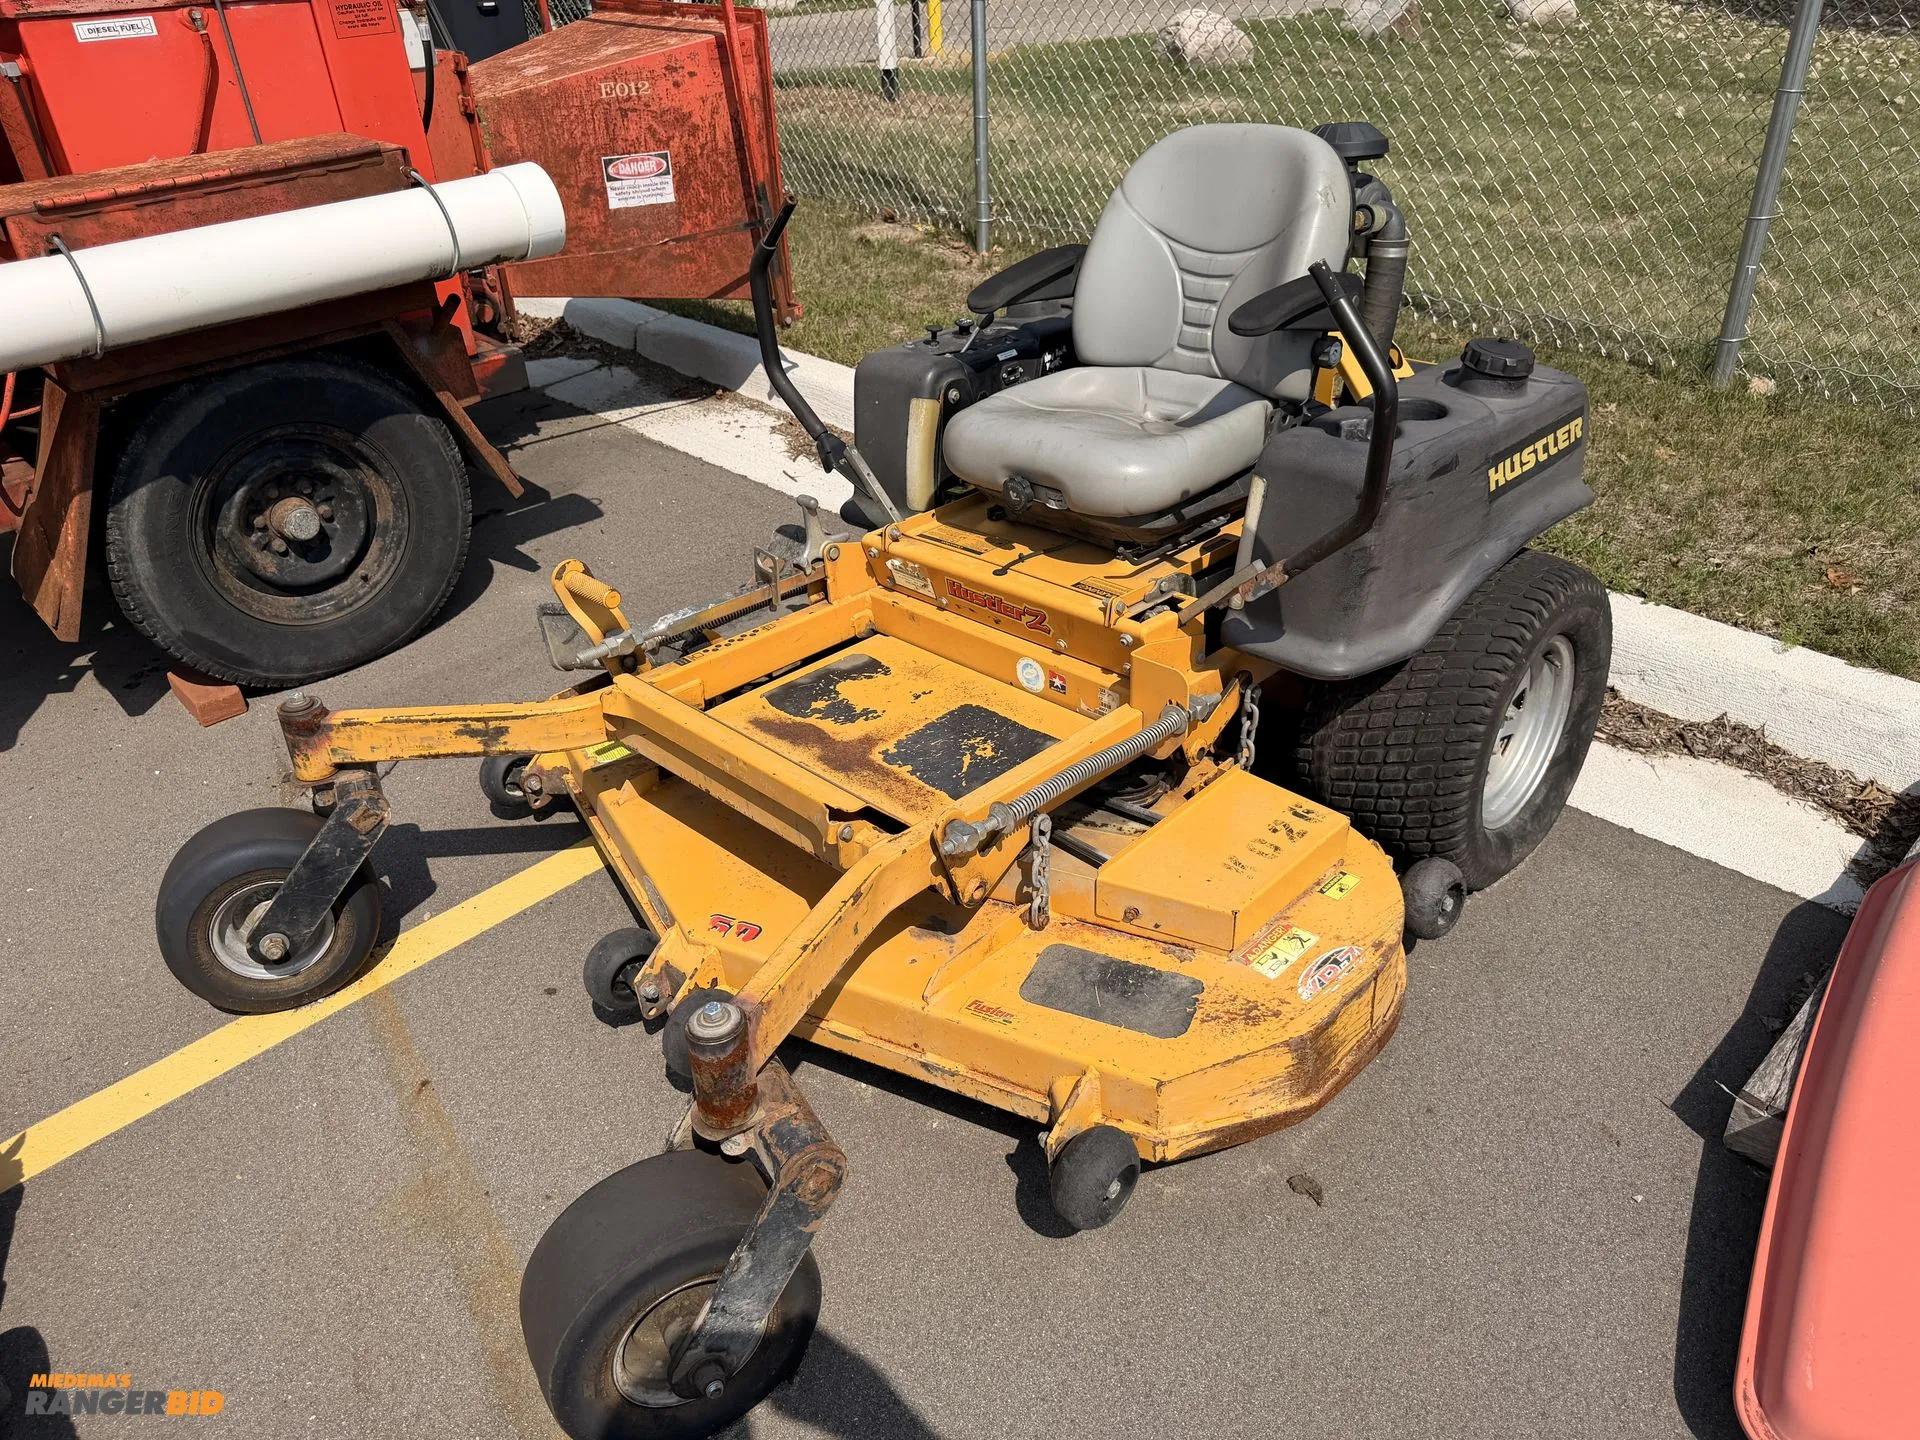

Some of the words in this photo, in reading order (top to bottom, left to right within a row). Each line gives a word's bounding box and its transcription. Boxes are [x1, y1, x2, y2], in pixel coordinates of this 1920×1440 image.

[336, 2, 371, 11] HYDRAULIC
[87, 25, 118, 35] DIESEL
[120, 23, 142, 32] FUEL
[598, 80, 651, 99] E012
[618, 160, 657, 175] DANGER
[1487, 416, 1584, 493] HUSTLER
